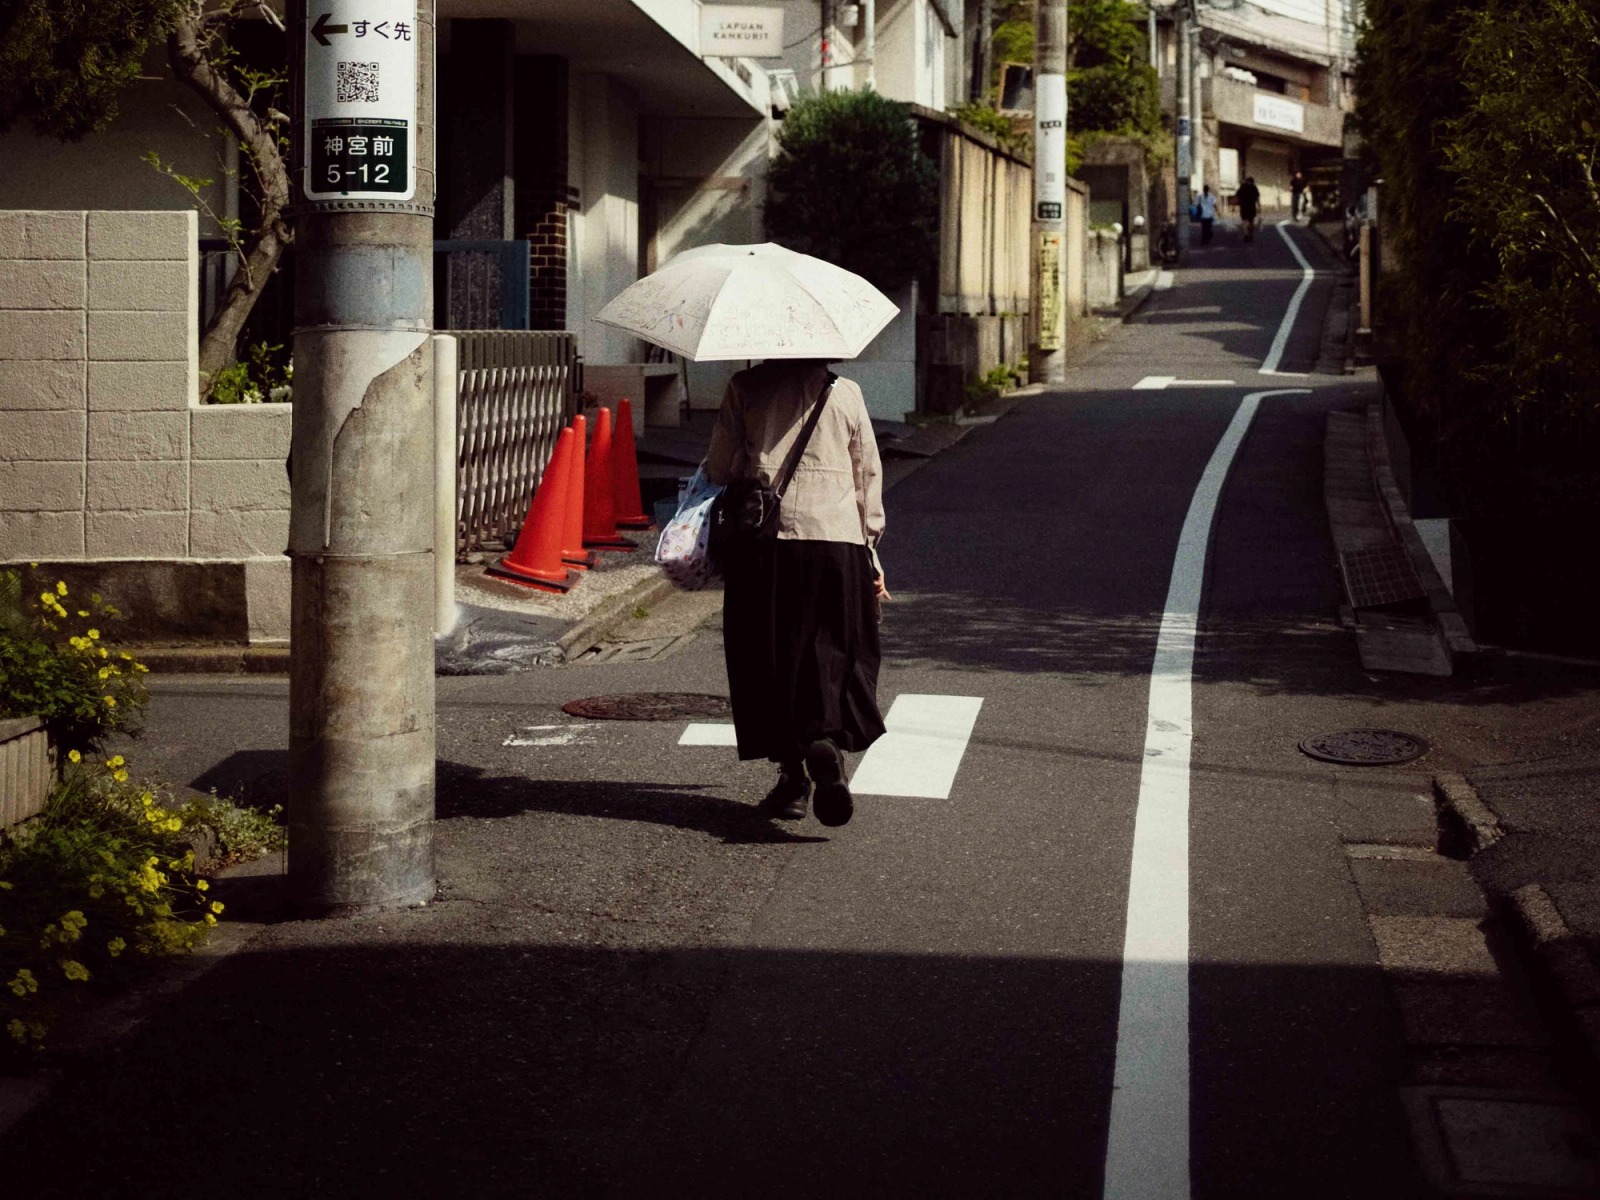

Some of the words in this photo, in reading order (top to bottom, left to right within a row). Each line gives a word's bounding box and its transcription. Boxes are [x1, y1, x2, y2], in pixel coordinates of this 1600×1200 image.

[352, 19, 411, 41] すぐ先
[713, 32, 769, 40] KANKURIT
[324, 135, 394, 156] 神宮前
[327, 163, 390, 184] 5-12
